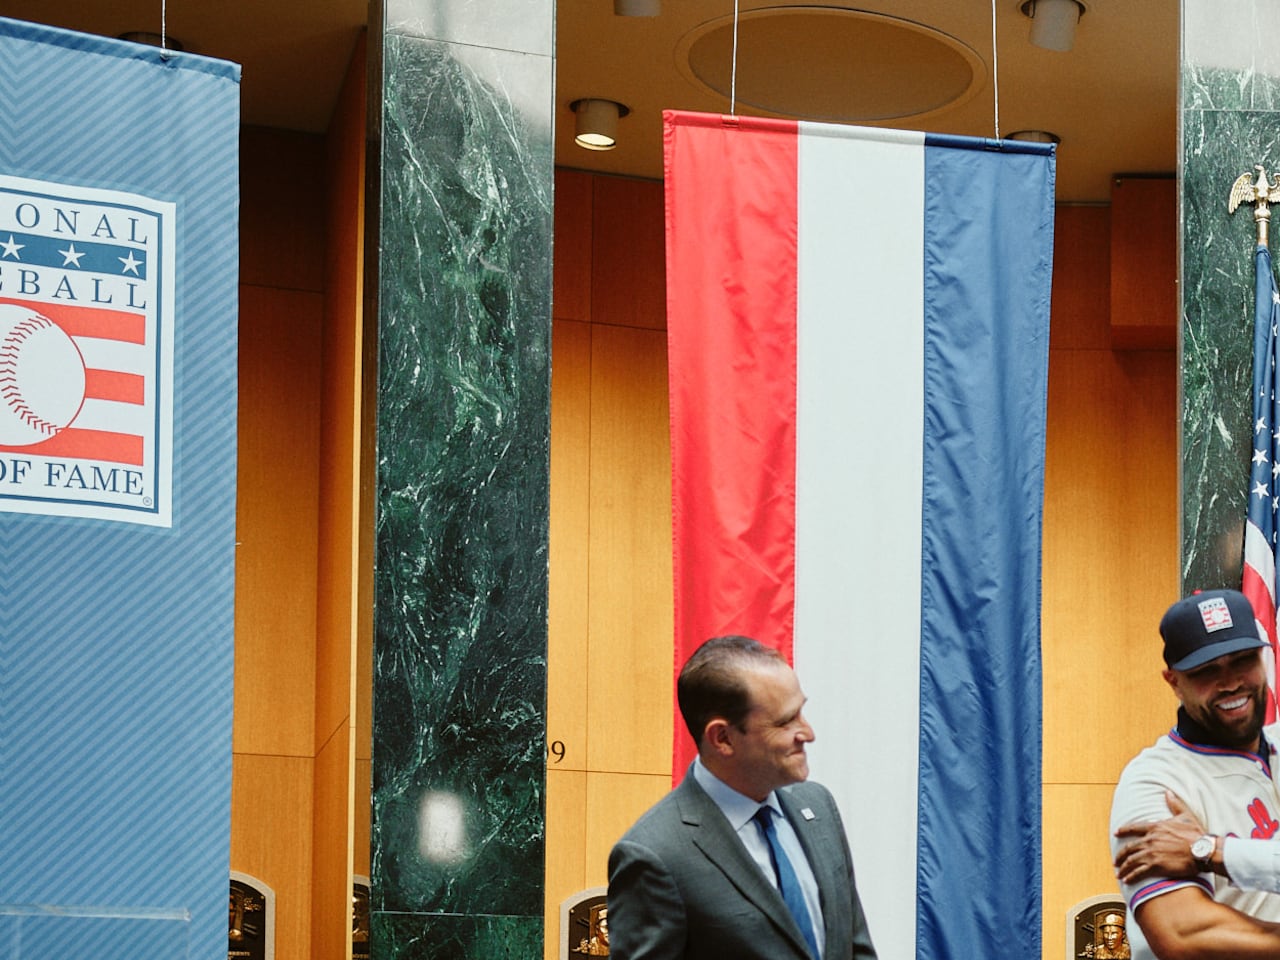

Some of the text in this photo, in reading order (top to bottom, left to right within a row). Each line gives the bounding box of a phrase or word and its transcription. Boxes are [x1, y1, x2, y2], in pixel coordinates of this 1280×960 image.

[0, 267, 147, 310] BALL
[44, 462, 144, 496] FAME
[547, 740, 566, 764] 9
